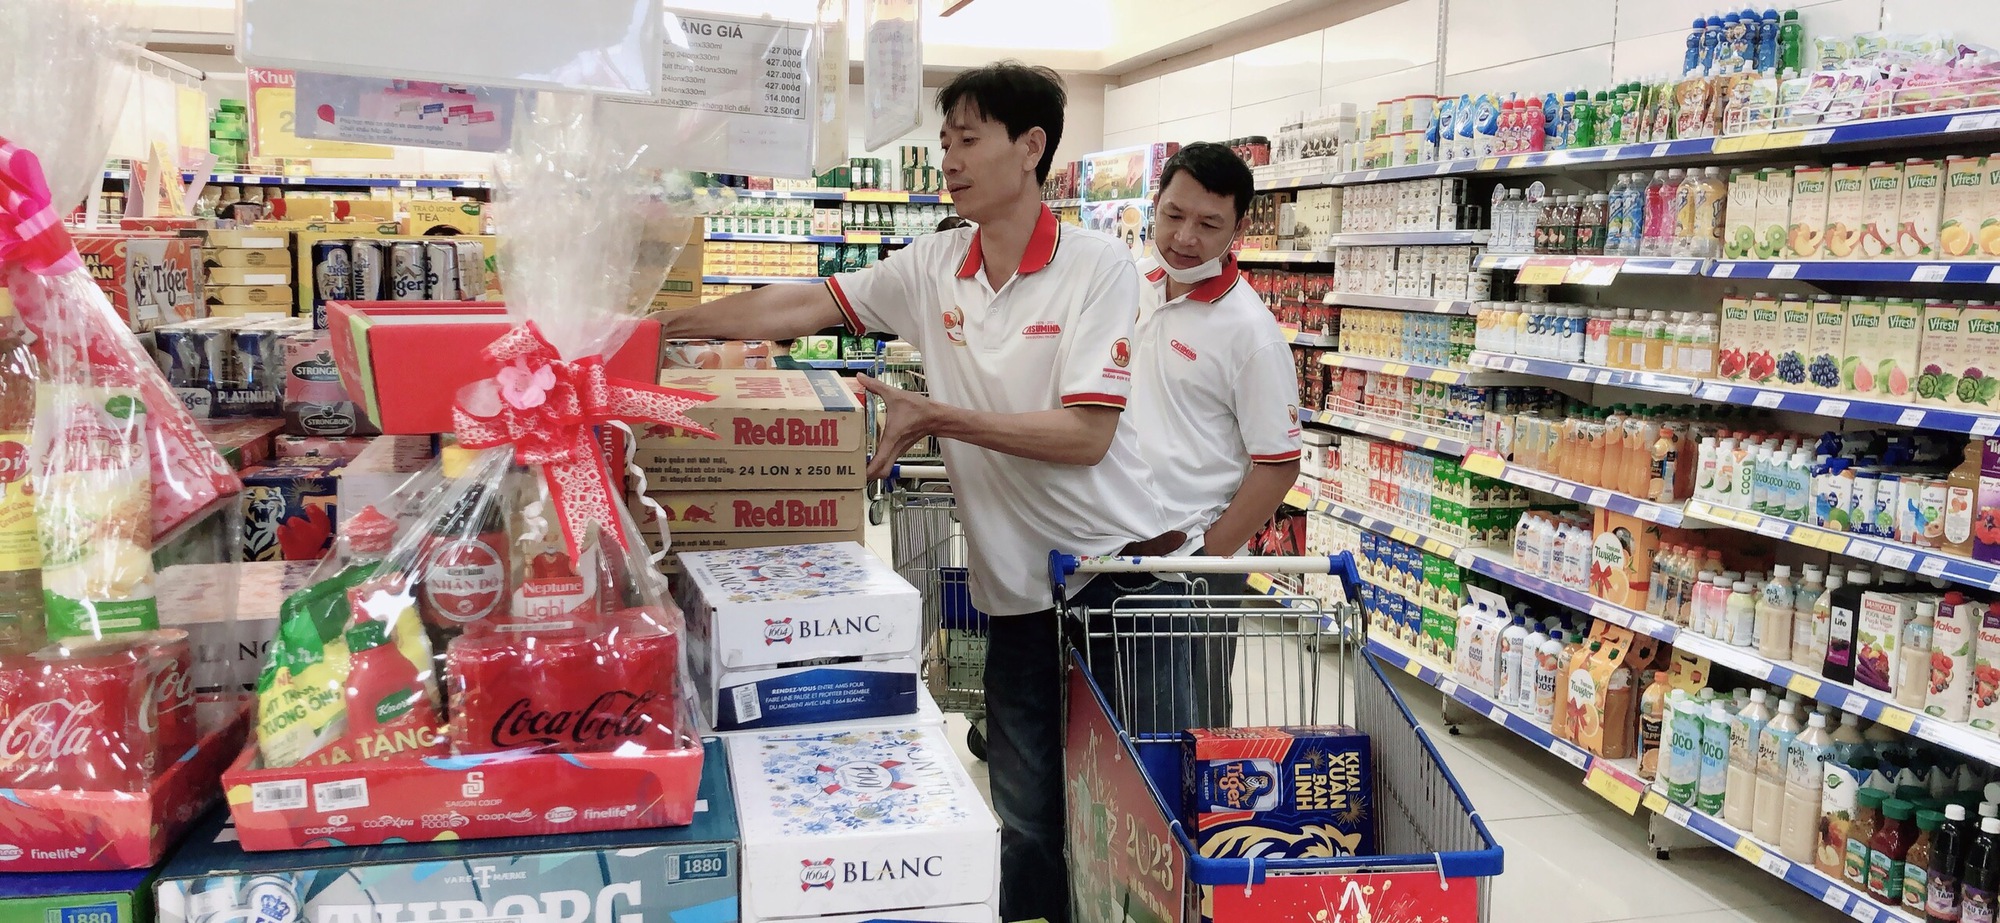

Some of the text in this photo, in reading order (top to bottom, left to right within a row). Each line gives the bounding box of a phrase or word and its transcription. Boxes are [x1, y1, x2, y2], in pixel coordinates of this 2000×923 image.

[681, 19, 743, 39] ẢNG GIÁ
[768, 47, 801, 57] 27.000đ
[766, 58, 801, 69] 427.000đ
[766, 70, 801, 80] 427.000đ
[765, 82, 801, 92] 427.000đ
[765, 94, 800, 104] 514.000đ
[764, 105, 800, 116] 252.500đ
[1835, 178, 1861, 193] Vfresh
[1870, 177, 1898, 191] Vfresh
[1908, 174, 1936, 189] Vfresh
[1951, 171, 1981, 187] Vfresh
[1797, 180, 1824, 194] Vfresh
[418, 213, 440, 222] TEA
[153, 258, 188, 306] Tiger
[392, 276, 424, 298] iger
[1726, 308, 1748, 320] Vfresh
[1753, 309, 1777, 321] Vfresh
[1785, 310, 1808, 323] Vfresh
[1816, 312, 1842, 325] Vfresh
[1852, 314, 1879, 328] Vfresh
[1888, 315, 1915, 329] Vfresh
[1928, 317, 1959, 332] Vfresh
[1968, 319, 2000, 334] Vfresh
[296, 367, 338, 376] STRONGB
[177, 390, 208, 411] iger
[217, 390, 277, 404] PLATINUM
[307, 418, 350, 426] STRONGBOW
[733, 417, 839, 446] Red Bull
[739, 465, 856, 475] 24 LON x 250 ML
[1741, 467, 1751, 495] COCO
[733, 499, 838, 527] Red Bull
[1595, 546, 1622, 564] Twister
[525, 580, 582, 594] Neptune
[526, 599, 565, 621] Light
[800, 615, 880, 638] BLANC
[1934, 620, 1961, 635] Malee
[772, 686, 816, 695] RENDEZ-VOUS
[1571, 681, 1594, 699] Twister
[377, 697, 416, 716] Knor
[491, 690, 658, 747] Coca-Cola
[1, 698, 103, 760] Cola
[1673, 734, 1693, 750] OCO
[1345, 752, 1361, 792] KHAI
[1219, 763, 1245, 809] Tiger
[1294, 763, 1314, 811] LĨNH
[1328, 753, 1349, 810] XUÂN
[584, 808, 628, 820] finelife
[0, 848, 23, 856] eers
[31, 848, 77, 860] finelife
[1126, 811, 1174, 892] 2023
[684, 858, 722, 874] 1880
[843, 855, 943, 883] BLANC
[805, 867, 830, 881] 1664
